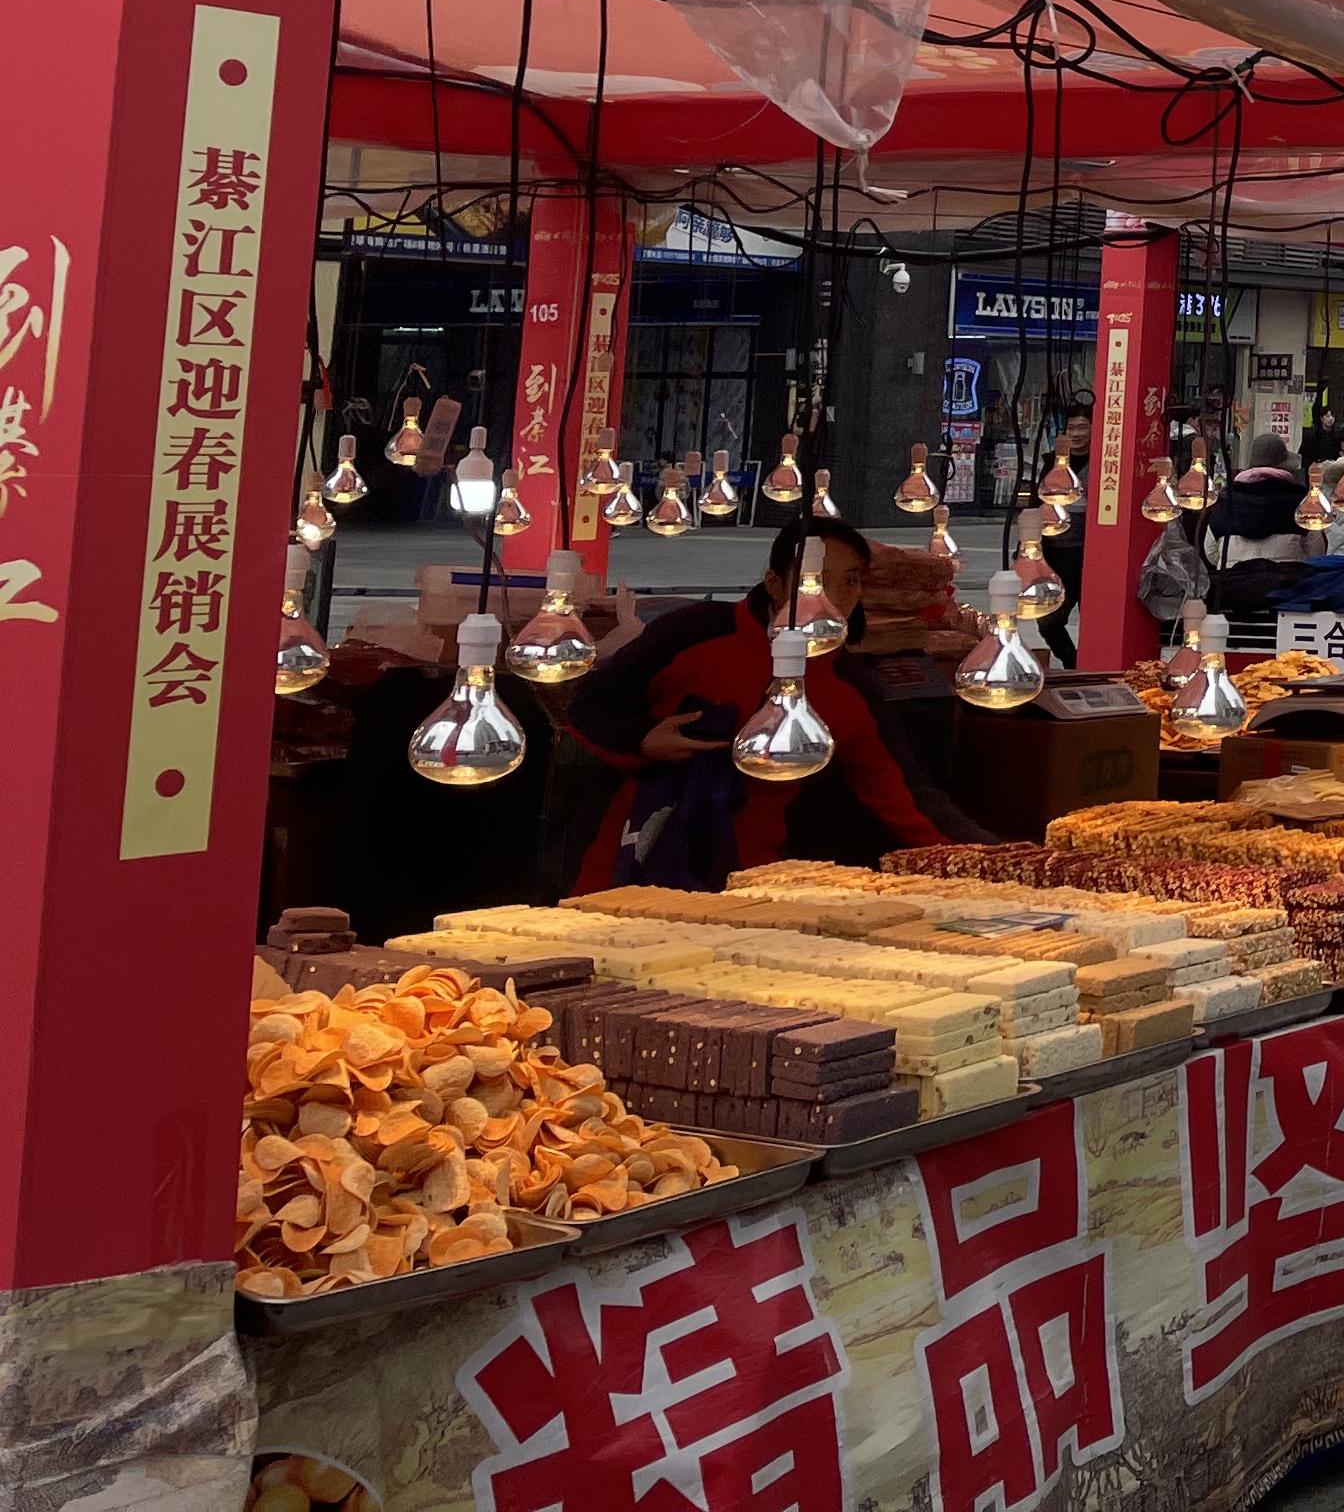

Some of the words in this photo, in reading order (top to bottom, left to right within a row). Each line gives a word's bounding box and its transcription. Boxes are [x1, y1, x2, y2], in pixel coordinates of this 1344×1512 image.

[529, 303, 558, 323] 105
[142, 146, 260, 707] 綦江区迎春展销会
[518, 364, 557, 478] 到綦江
[1102, 361, 1126, 492] 綦江区迎春展销会
